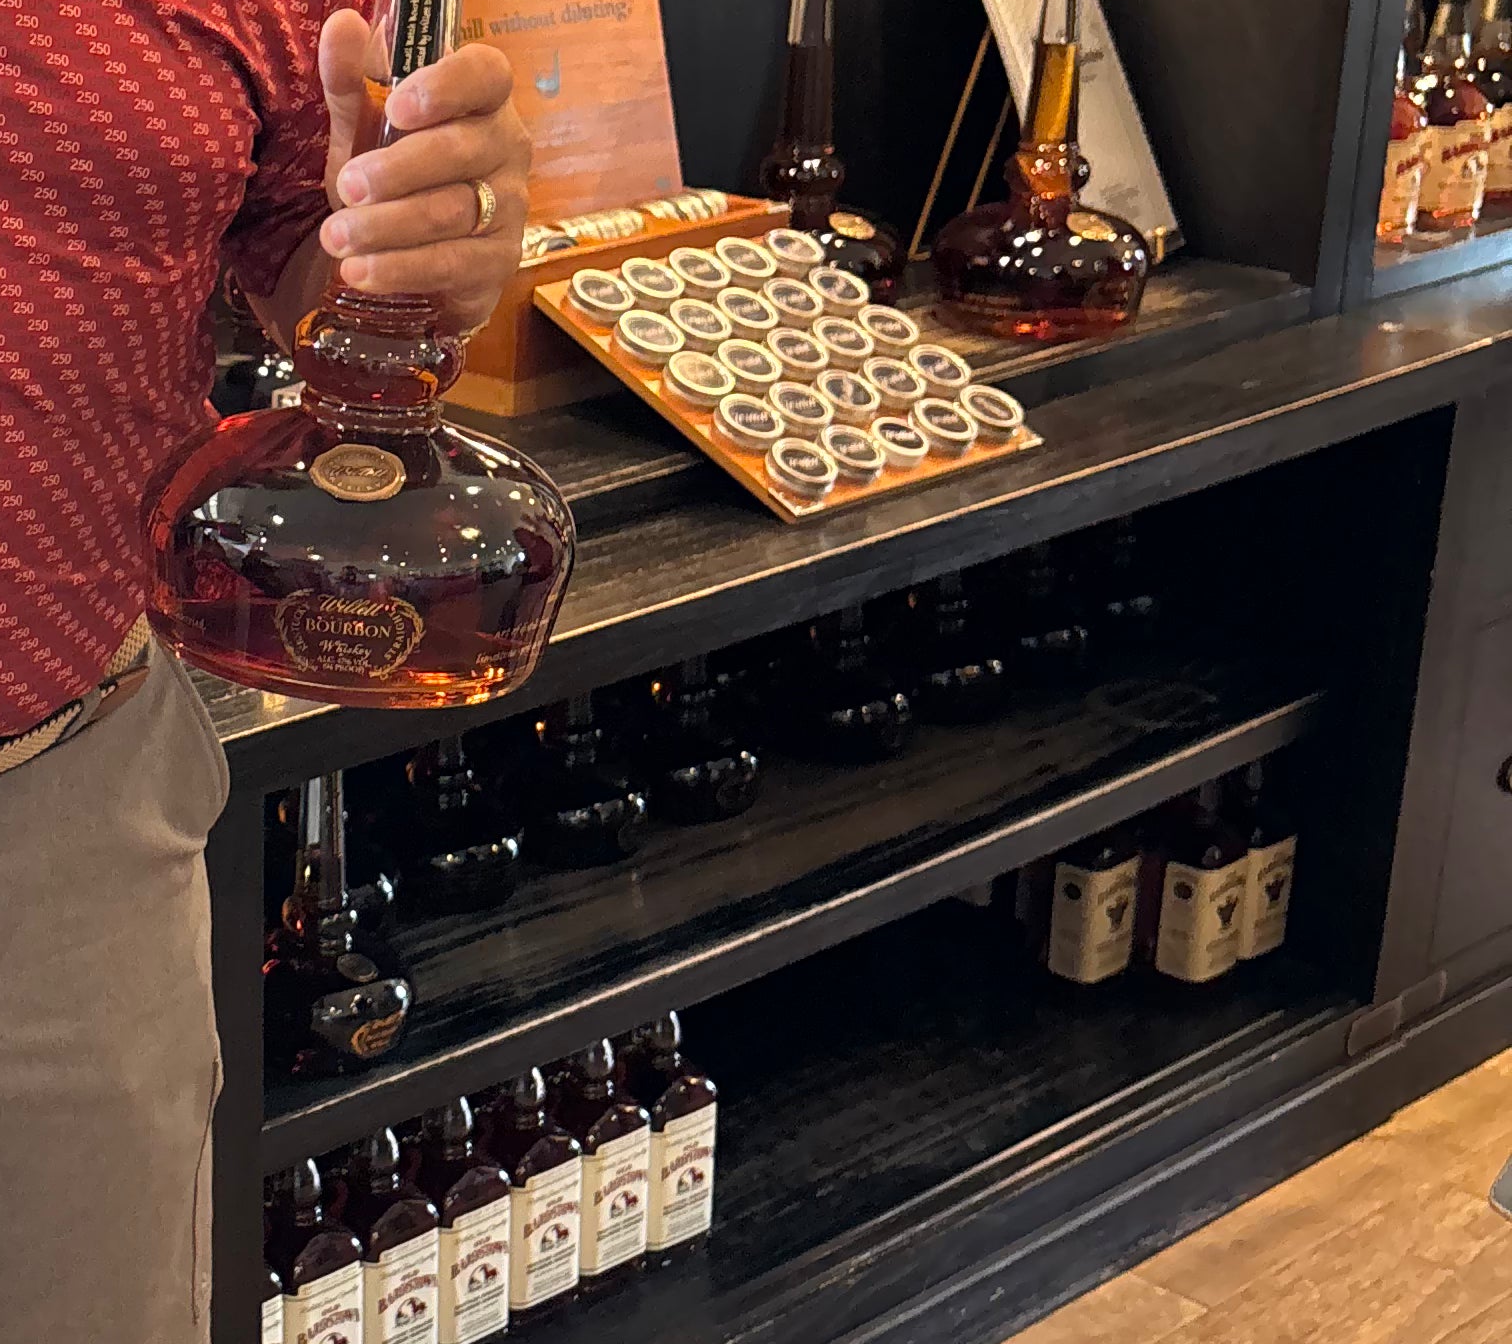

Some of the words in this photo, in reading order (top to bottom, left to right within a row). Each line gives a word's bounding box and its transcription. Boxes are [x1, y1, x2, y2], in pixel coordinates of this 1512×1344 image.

[489, 10, 556, 37] without
[135, 182, 158, 196] 250
[317, 593, 384, 617] Willett
[305, 616, 393, 639] BOURBON
